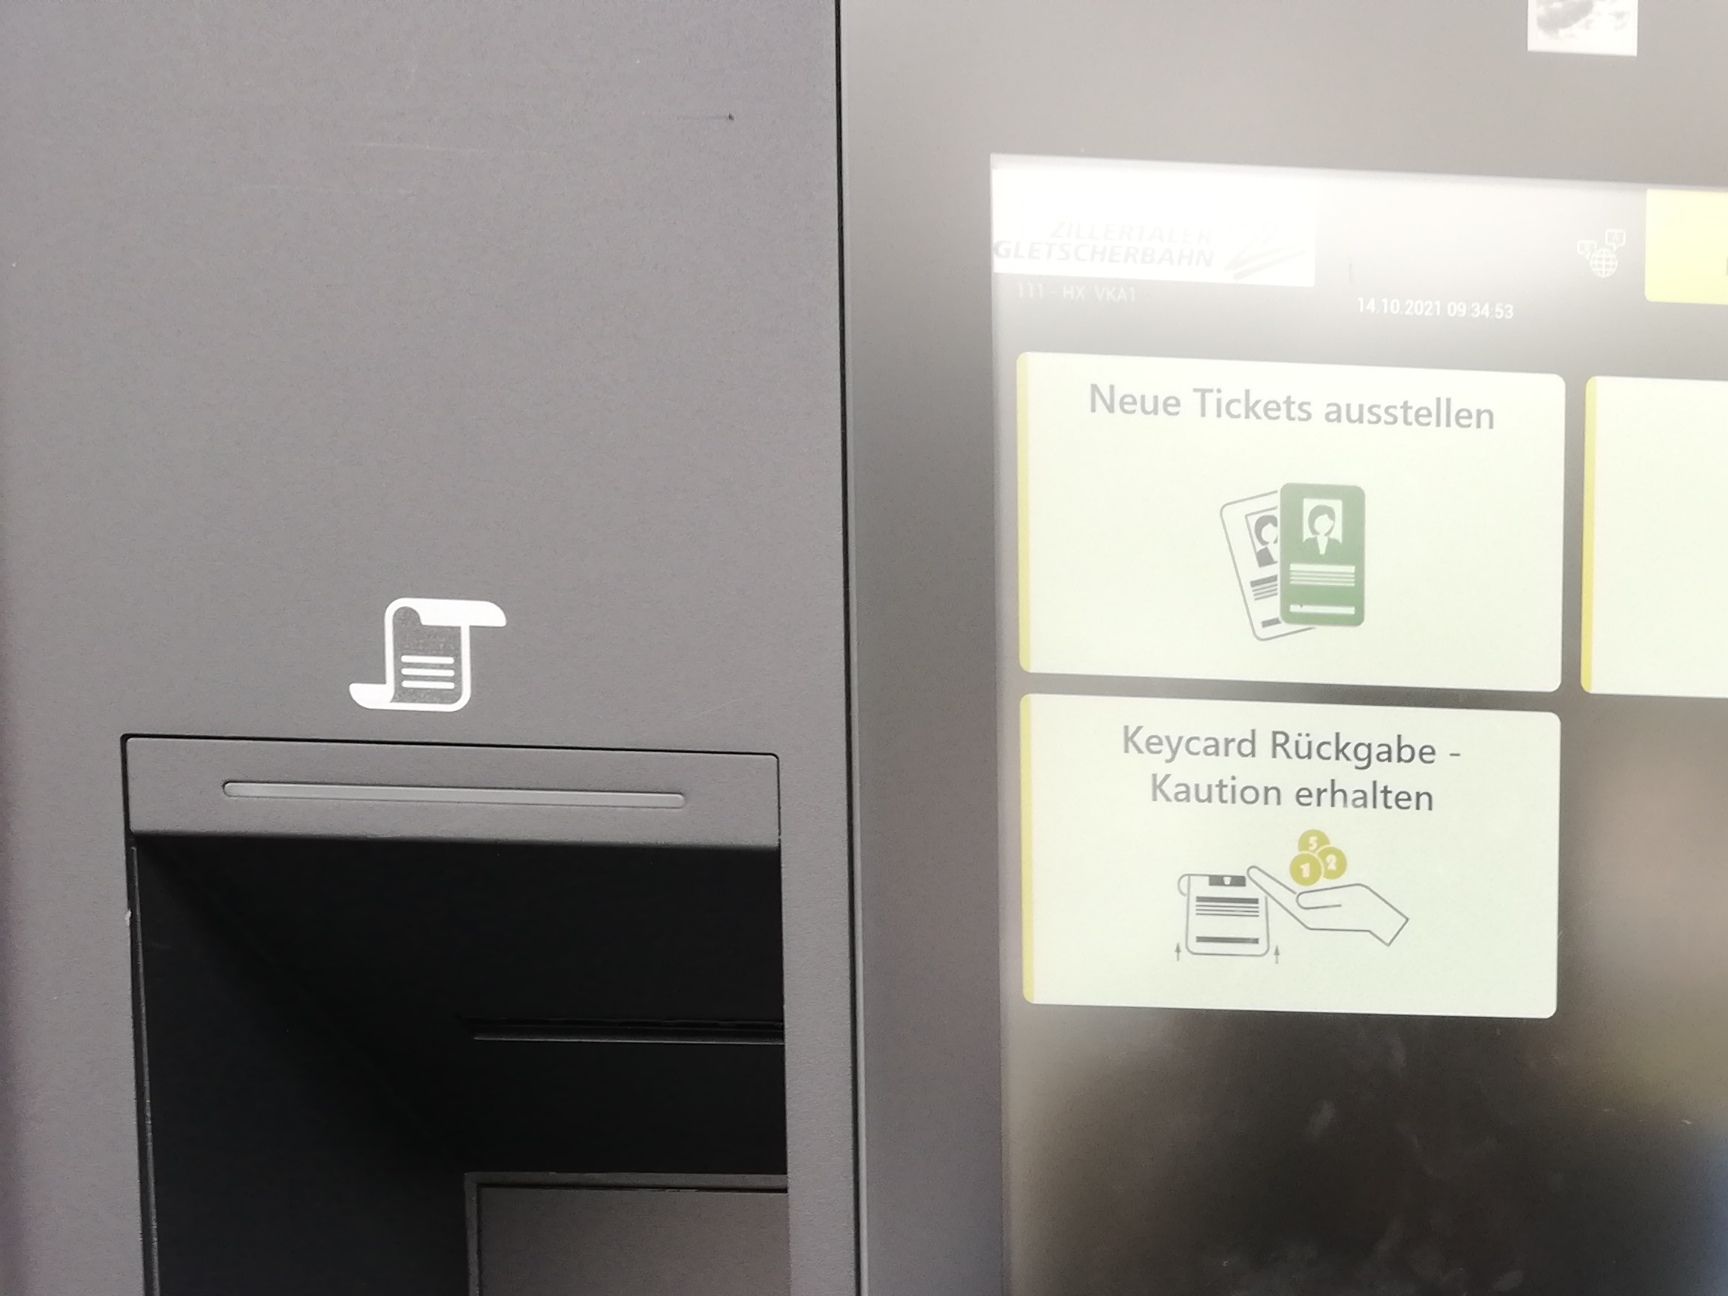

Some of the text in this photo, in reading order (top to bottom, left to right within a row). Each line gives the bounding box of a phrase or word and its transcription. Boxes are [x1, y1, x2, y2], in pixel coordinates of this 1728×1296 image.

[1049, 219, 1214, 246] ZILLERTALER
[993, 239, 1215, 268] GLETSCHERBAHN
[1357, 297, 1515, 319] 14.10.2021 09:34:53
[1088, 383, 1496, 430] Neue Tickets ausstellen
[1121, 724, 1258, 764] Keycard
[1269, 729, 1437, 770] Rückgabe
[1150, 773, 1435, 812] Kaution erhalten
